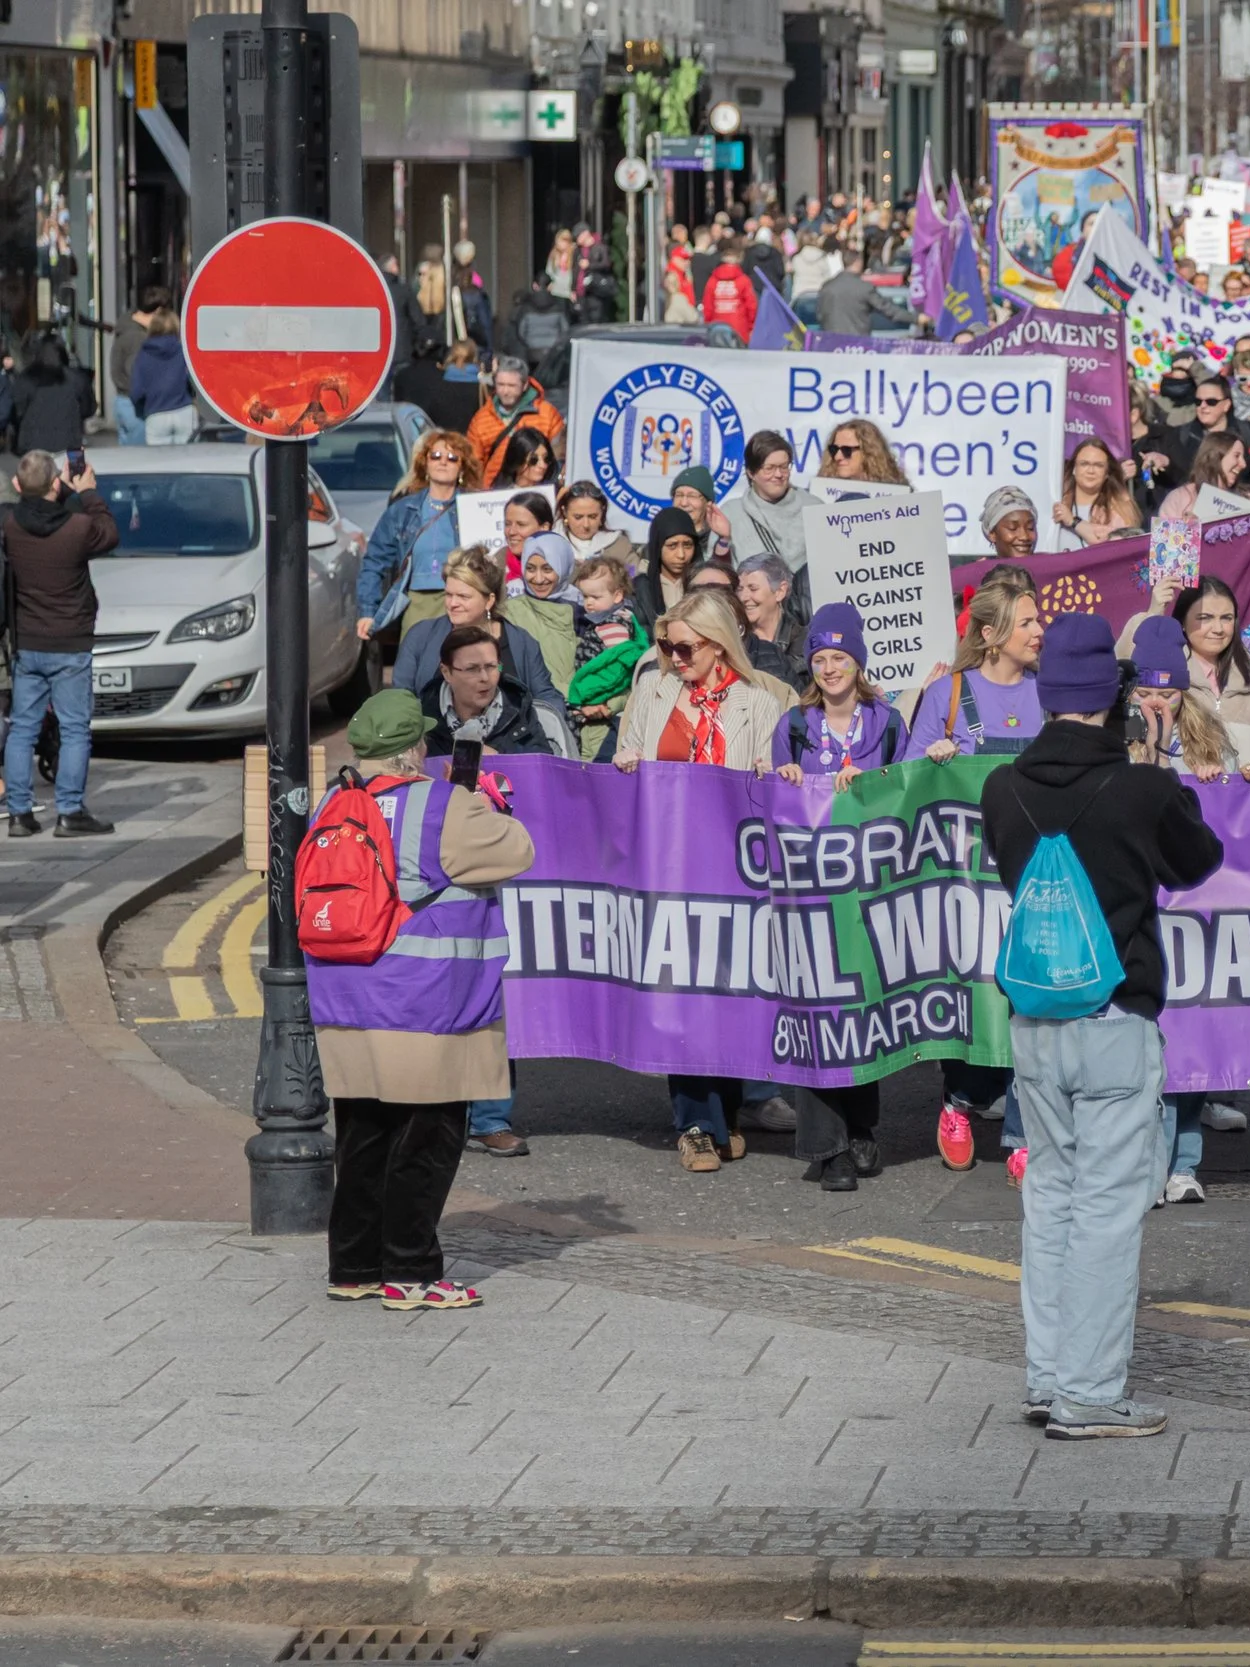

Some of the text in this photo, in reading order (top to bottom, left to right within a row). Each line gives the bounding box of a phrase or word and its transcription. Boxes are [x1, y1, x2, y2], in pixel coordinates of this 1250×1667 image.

[1129, 262, 1170, 302] REST
[1006, 321, 1118, 350] WOMEN'S
[598, 366, 741, 436] BALLYBEEN
[788, 367, 1053, 428] Ballybeen
[785, 428, 1038, 477] Wmen's
[826, 505, 920, 528] Women's Aid
[859, 540, 896, 558] END
[835, 561, 925, 585] VIOLENCE
[861, 611, 923, 632] OMEN
[872, 636, 923, 656] GIRLS
[867, 662, 915, 682] NOW
[774, 990, 968, 1062] 8TH MARCH
